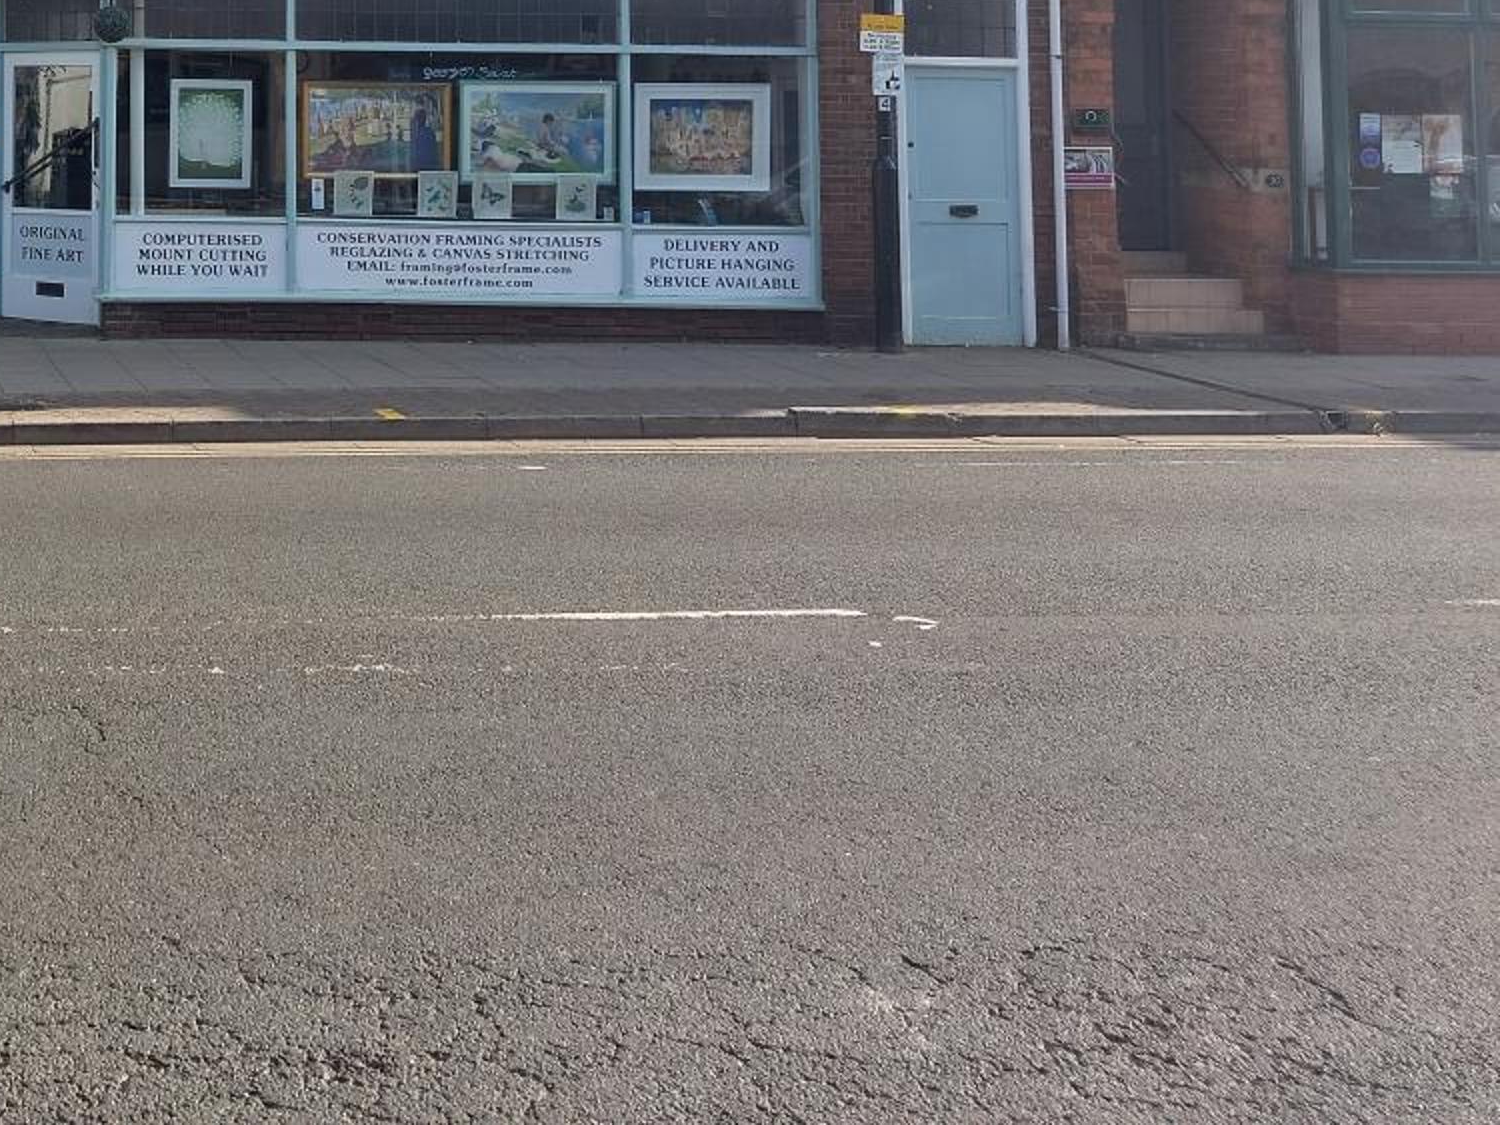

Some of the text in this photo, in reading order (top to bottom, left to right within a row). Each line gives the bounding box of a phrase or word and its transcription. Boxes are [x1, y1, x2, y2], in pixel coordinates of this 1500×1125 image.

[19, 225, 85, 242] ORIGINAL
[142, 233, 263, 246] COMPUTERISED
[316, 232, 603, 249] CONSERVATION FRAMING SPECIALISTS
[664, 238, 780, 253] DELIVERY AND
[21, 246, 84, 263] FINE ART
[138, 248, 267, 263] MOUNT CUTTING
[329, 246, 590, 262] REGLAZING & CANVAS STRETCHING
[135, 264, 270, 278] WHILE YOU WAIT
[346, 260, 573, 276] EMAIL: framing@fosterframe.com
[650, 256, 796, 272] PICTURE HANGING
[384, 276, 534, 289] www.fosterframe.com
[643, 275, 801, 290] SERVICE AVAILABLE
